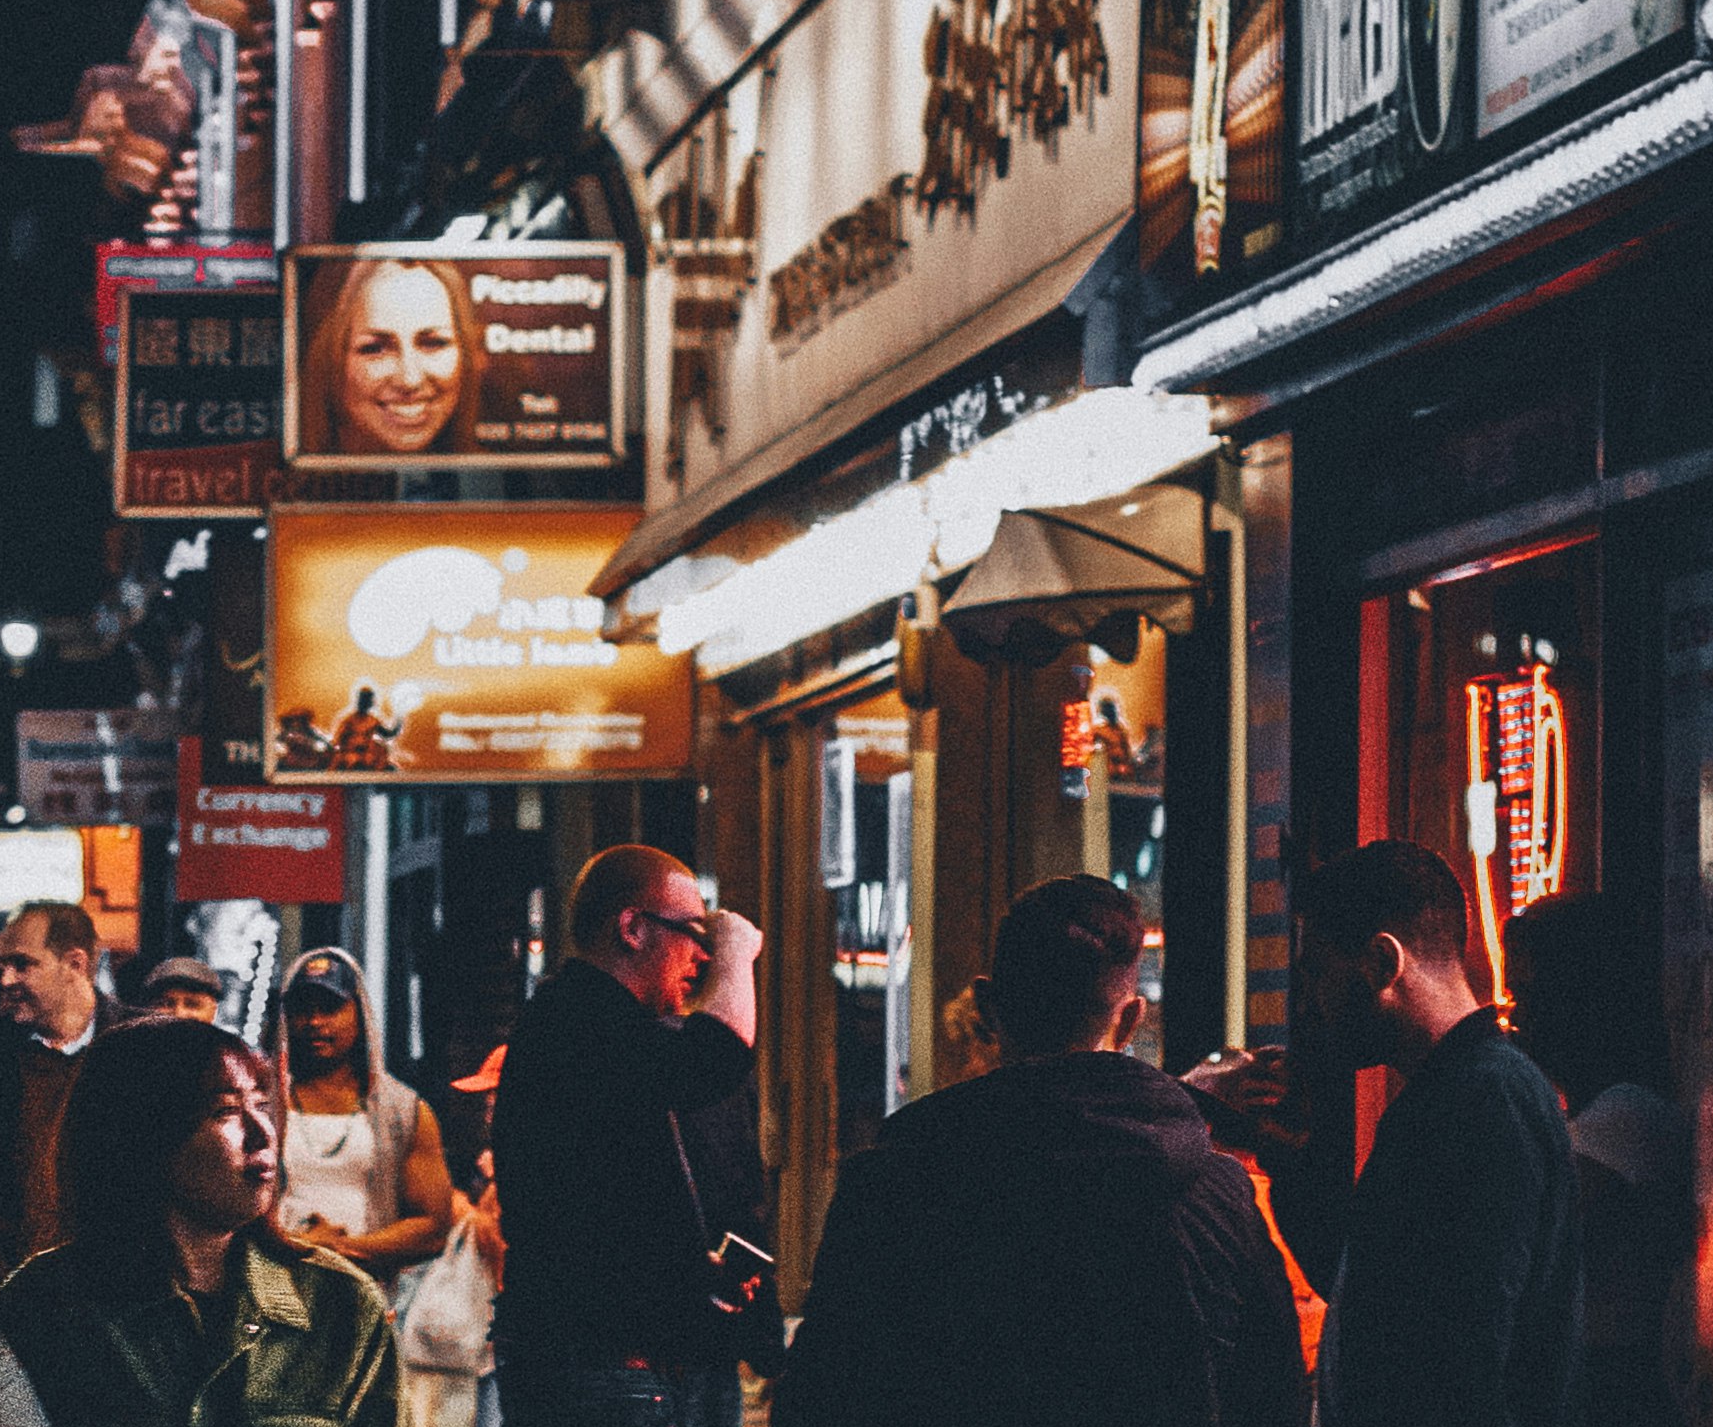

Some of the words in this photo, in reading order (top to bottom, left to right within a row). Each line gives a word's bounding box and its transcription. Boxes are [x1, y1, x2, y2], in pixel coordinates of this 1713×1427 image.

[485, 323, 596, 354] Dental
[136, 388, 187, 435] far
[134, 455, 251, 503] travel
[196, 786, 326, 818] Currency
[192, 823, 331, 852] Exchange
